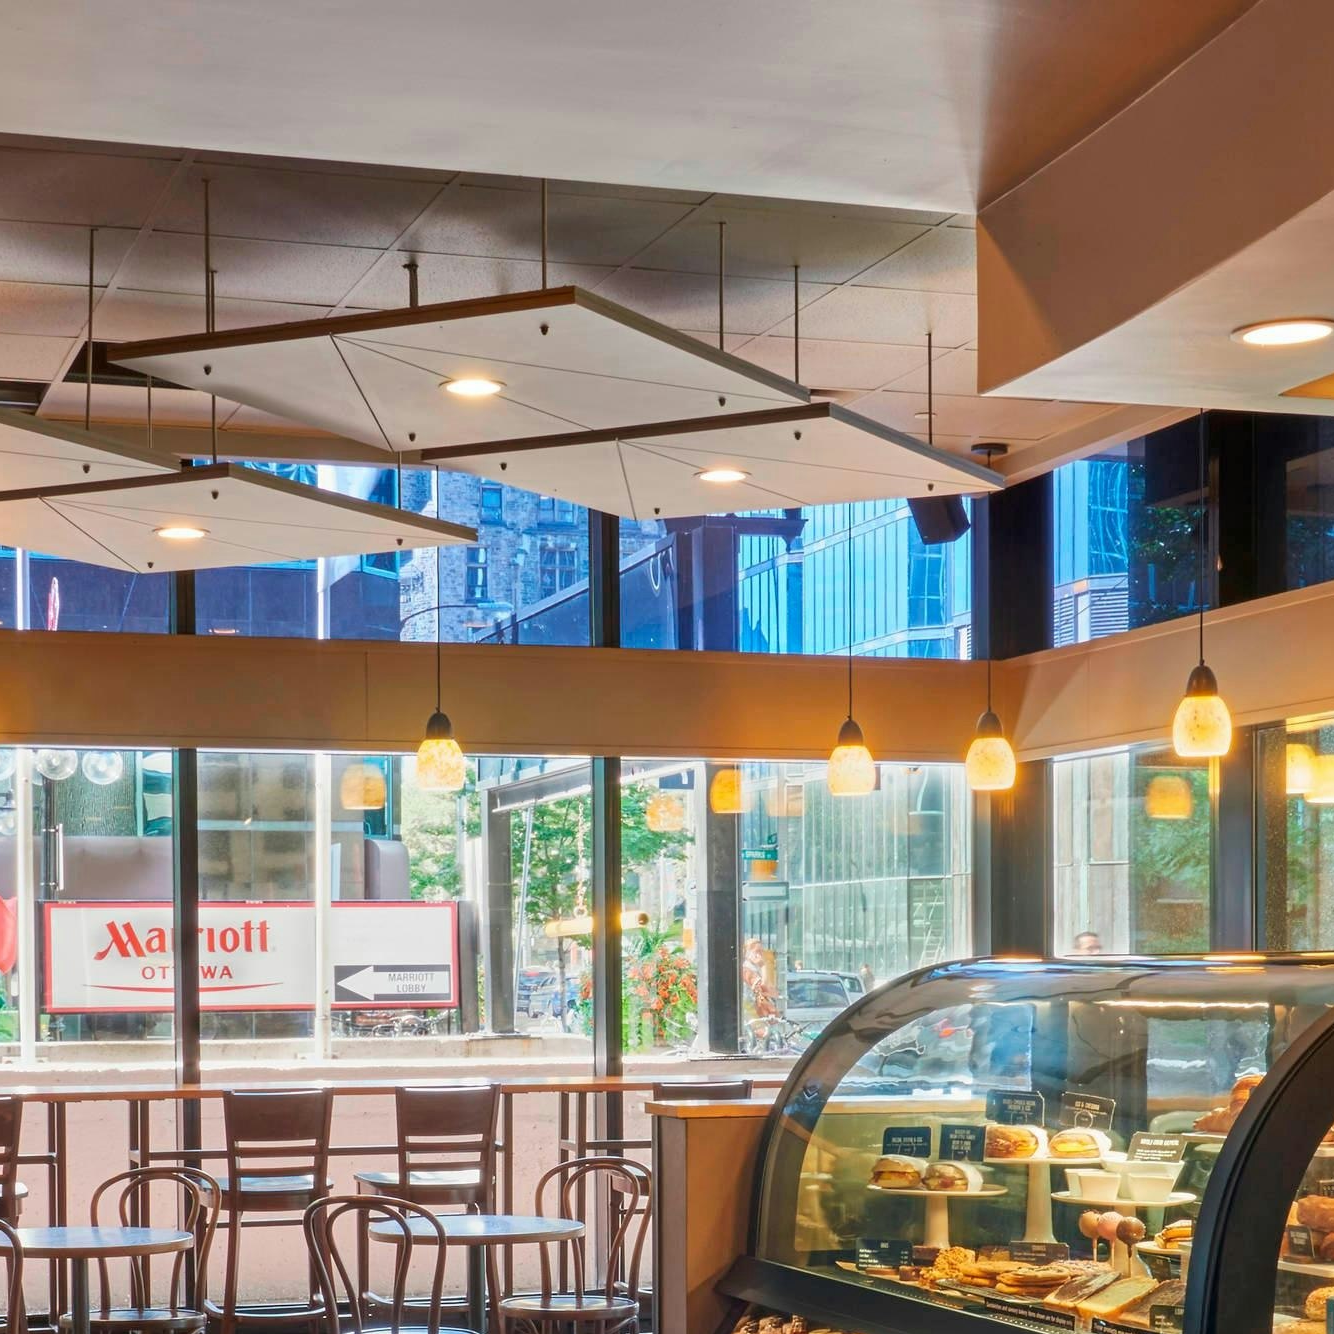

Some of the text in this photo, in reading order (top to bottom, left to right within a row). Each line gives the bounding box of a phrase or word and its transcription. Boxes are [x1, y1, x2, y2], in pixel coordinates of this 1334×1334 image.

[93, 919, 271, 960] Maiott
[141, 966, 233, 980] OTWA
[387, 972, 435, 983] MARRIOTT
[396, 984, 427, 993] LOBBY
